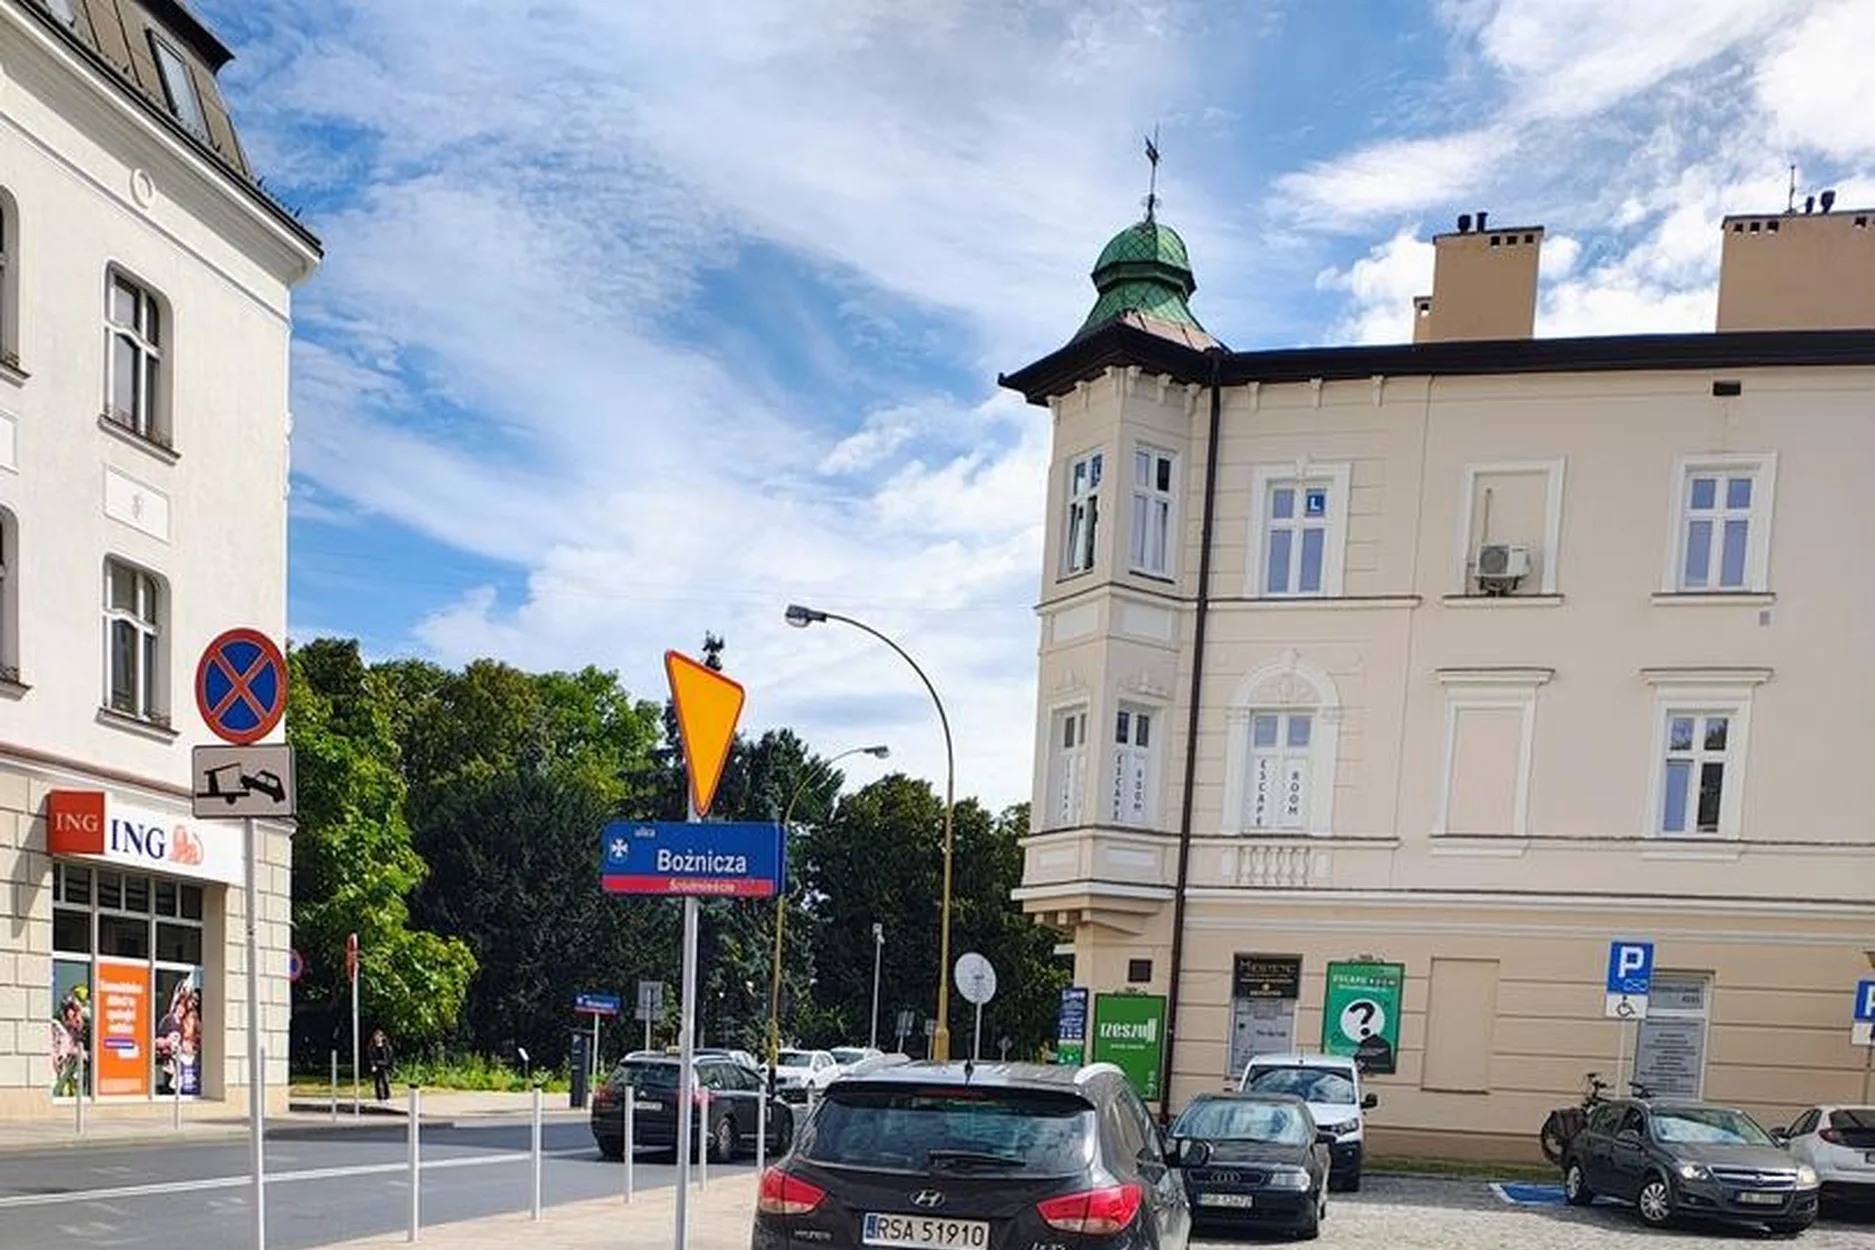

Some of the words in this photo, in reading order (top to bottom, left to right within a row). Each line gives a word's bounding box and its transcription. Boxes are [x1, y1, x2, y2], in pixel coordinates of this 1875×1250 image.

[1287, 769, 1300, 815] ROOM
[54, 812, 99, 832] ING
[111, 819, 166, 860] ING
[657, 849, 747, 873] Bożnicza
[1618, 946, 1644, 978] P
[877, 1217, 914, 1240] RSA
[922, 1221, 985, 1246] 51910
